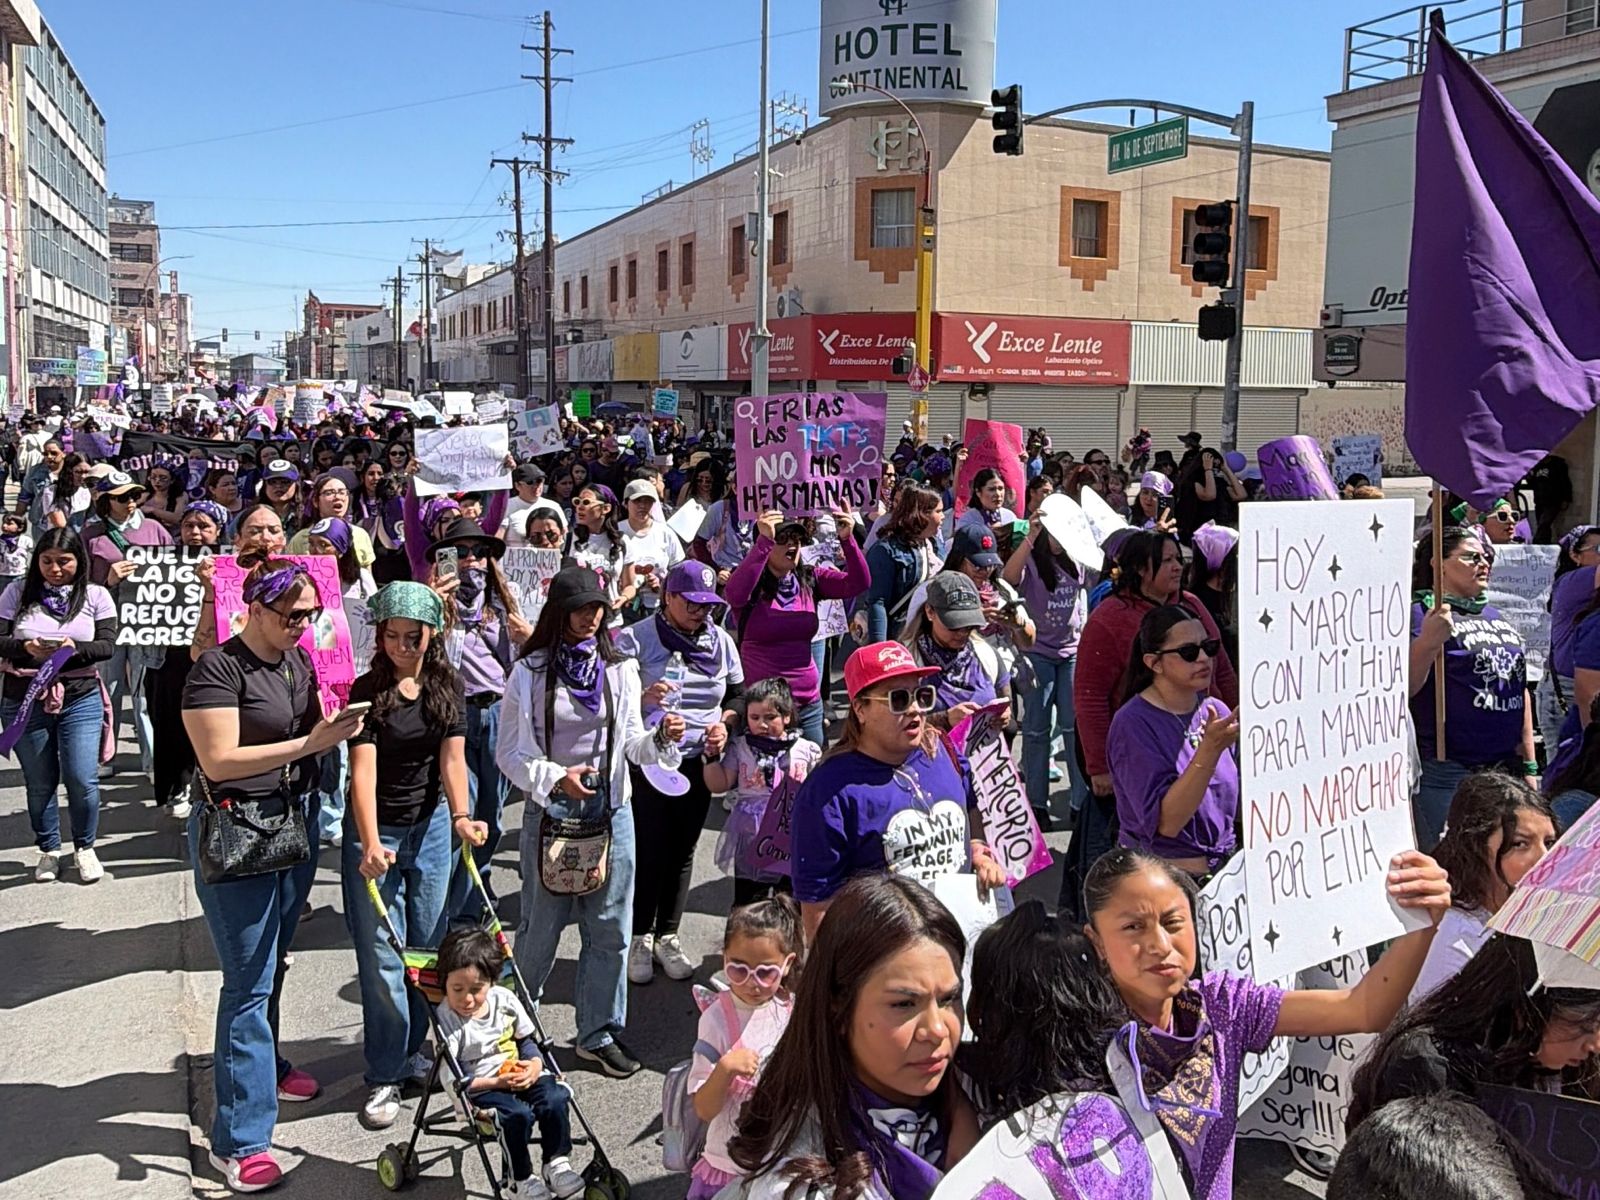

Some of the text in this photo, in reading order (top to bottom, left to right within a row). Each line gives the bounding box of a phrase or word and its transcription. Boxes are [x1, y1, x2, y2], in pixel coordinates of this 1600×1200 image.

[834, 23, 962, 65] HOTEL
[830, 66, 968, 98] CONTINENTAL
[1123, 141, 1131, 160] 16
[1132, 138, 1142, 158] DE
[1143, 127, 1183, 155] SEPTIEMBRE
[771, 333, 795, 352] Lente
[839, 334, 872, 348] Exce
[997, 330, 1103, 355] Exce Lente
[829, 357, 889, 366] Distribuidora De
[752, 425, 788, 449] LAS
[755, 451, 842, 485] NO MIS
[743, 478, 879, 512] HERMANAS!
[126, 545, 178, 566] QUE
[182, 545, 213, 565] LA
[1256, 528, 1325, 595] HOY
[126, 565, 200, 584] LA IG
[136, 583, 177, 604] NO
[1290, 581, 1405, 651] MARCHO
[115, 626, 196, 646] AGRES
[1251, 655, 1303, 709] CON
[1248, 690, 1407, 778] PARA MAÑANA
[976, 737, 1033, 862] MERCURIO
[1250, 752, 1407, 850] NO MARCHAR
[893, 827, 965, 861] FEMININE
[904, 811, 952, 845] IN MY
[911, 848, 953, 869] RAGE
[1265, 840, 1312, 905] POR
[1208, 893, 1247, 961] Por
[1277, 1064, 1341, 1097] gana
